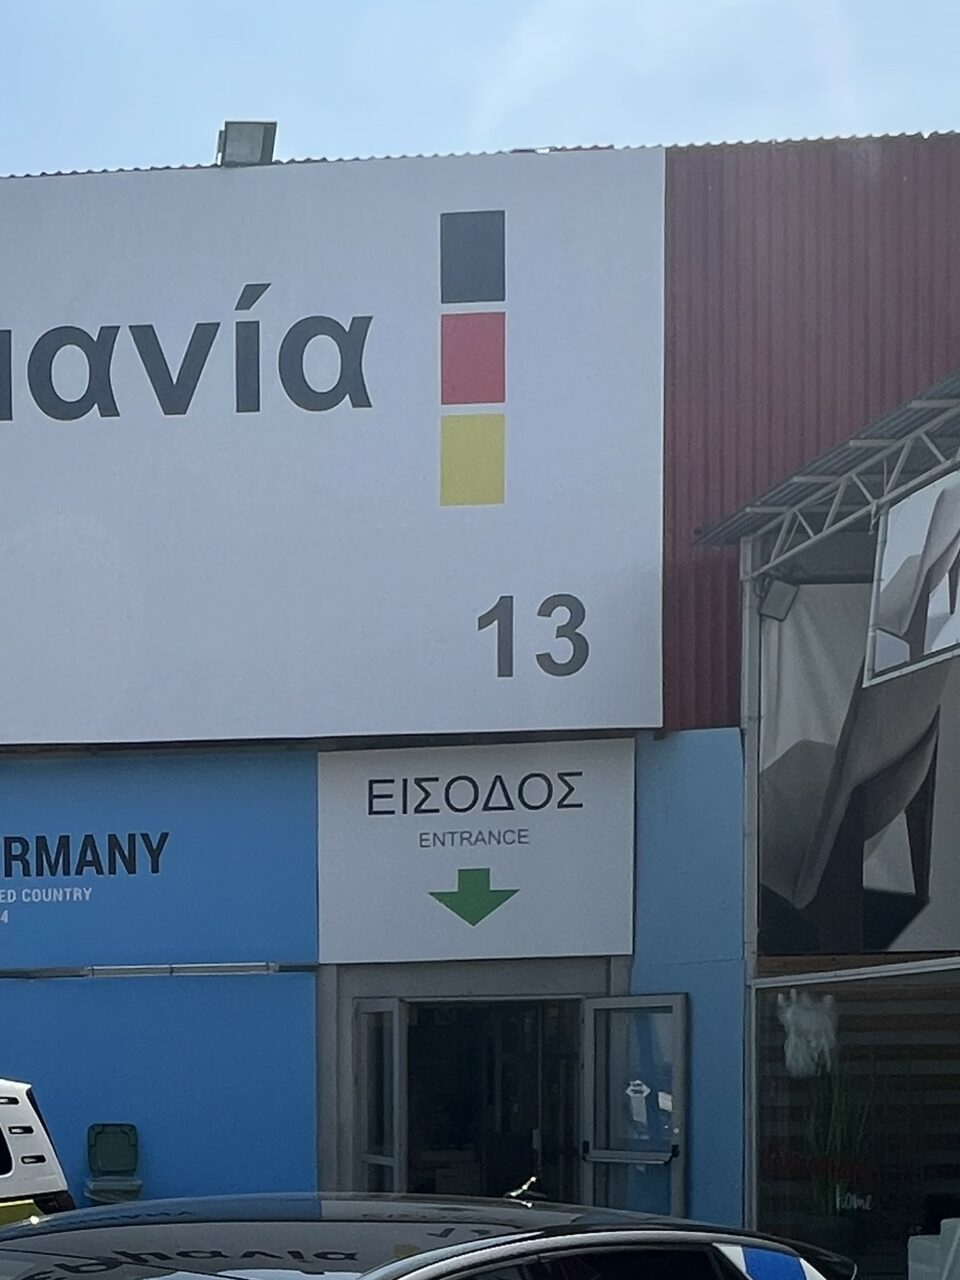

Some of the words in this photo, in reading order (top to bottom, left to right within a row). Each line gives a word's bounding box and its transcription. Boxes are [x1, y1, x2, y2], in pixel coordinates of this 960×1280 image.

[477, 593, 590, 678] 13
[368, 772, 584, 815] ΕΙΣΟΔΟΣ
[418, 828, 530, 848] ENTRANCE
[21, 887, 93, 903] COUNTRY
